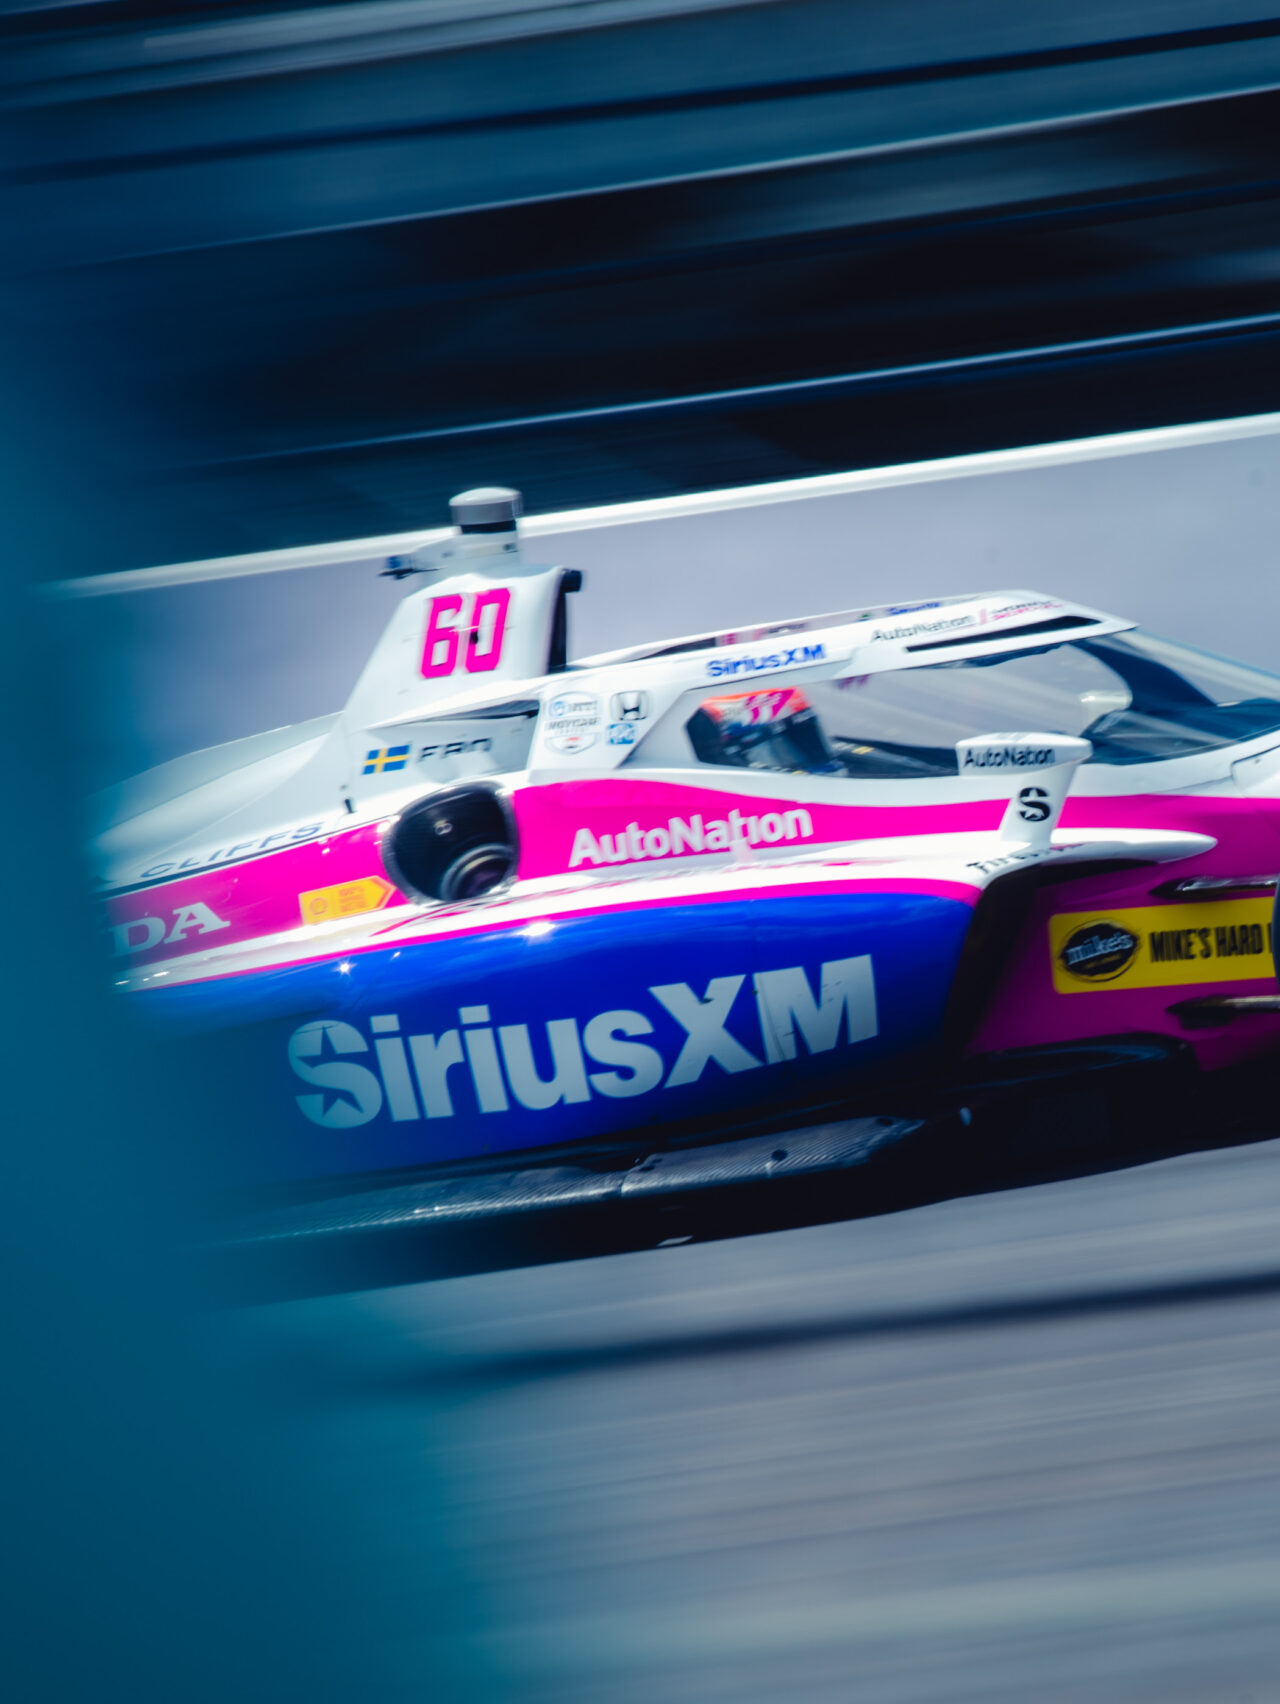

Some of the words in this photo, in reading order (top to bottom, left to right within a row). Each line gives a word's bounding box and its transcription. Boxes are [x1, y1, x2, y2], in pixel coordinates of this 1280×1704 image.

[420, 586, 511, 679] 60
[871, 615, 976, 643] AutoNation
[706, 643, 827, 678] SiriusXM
[964, 746, 1056, 769] AutoNation
[140, 821, 324, 878] CLIFFS
[568, 807, 814, 868] AutoNation
[1148, 927, 1211, 963] MIKE'S
[1214, 923, 1264, 958] HARD
[287, 954, 879, 1130] SiriusXM
